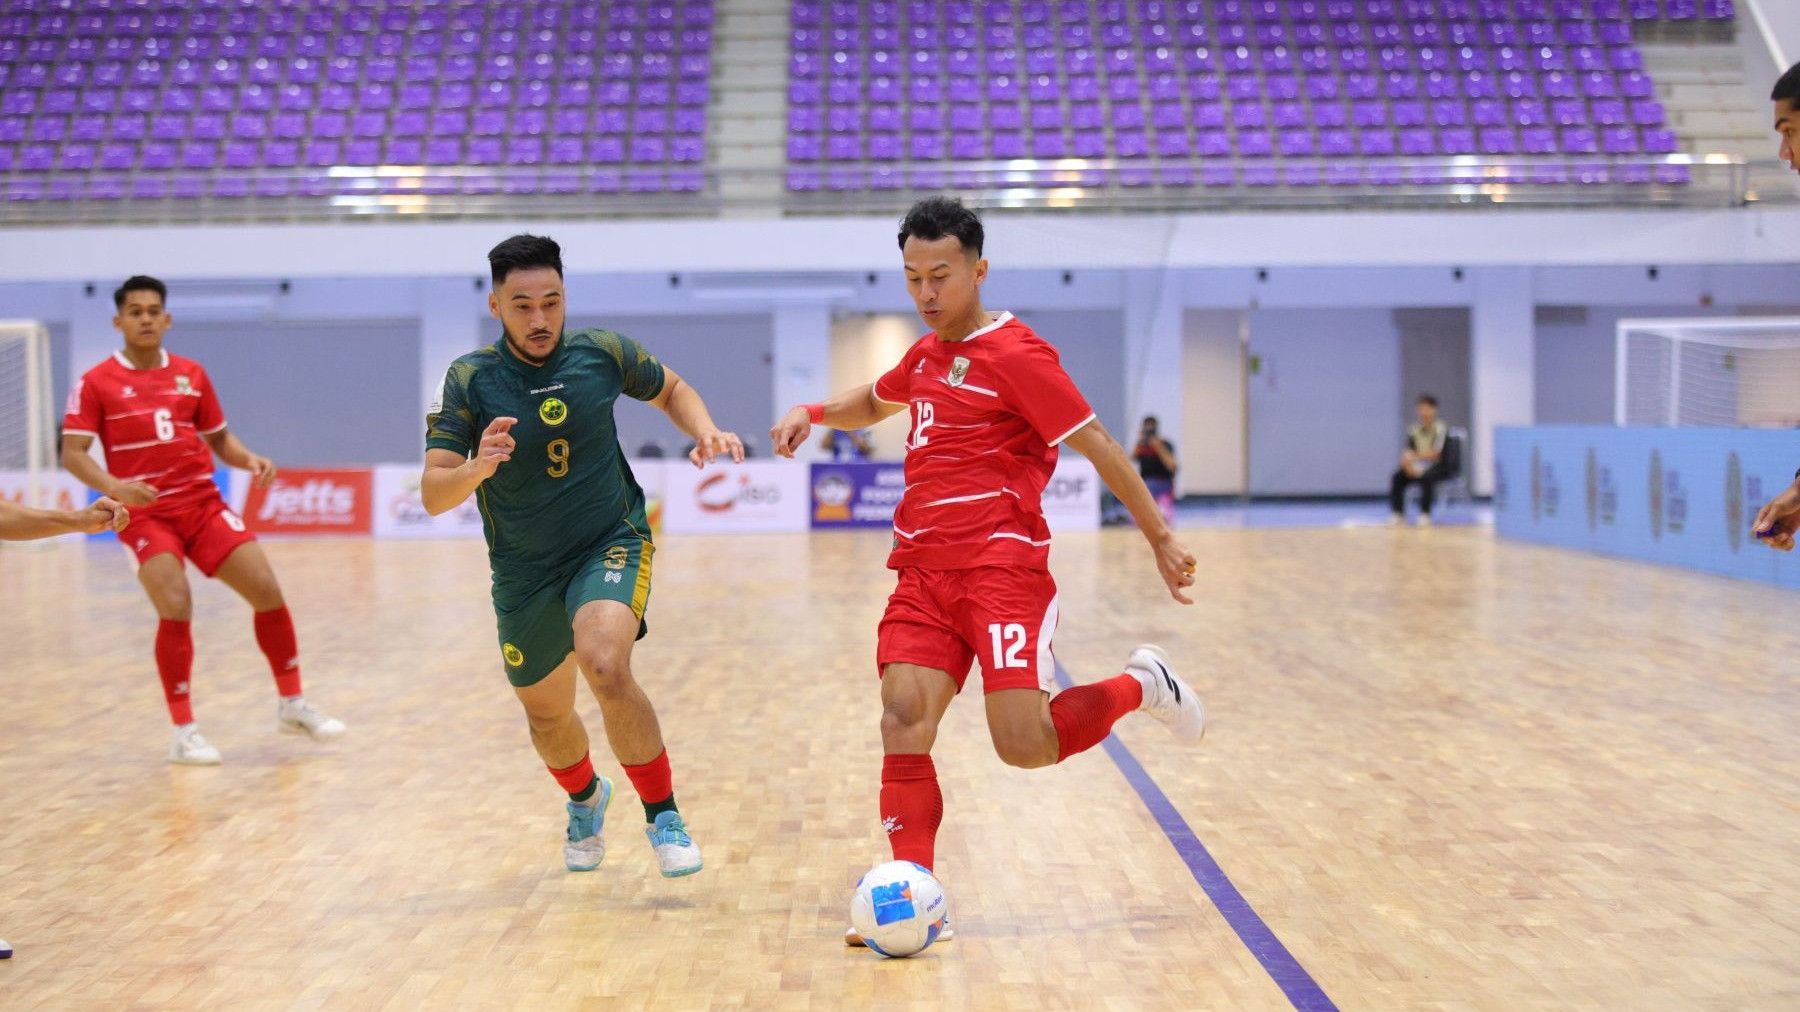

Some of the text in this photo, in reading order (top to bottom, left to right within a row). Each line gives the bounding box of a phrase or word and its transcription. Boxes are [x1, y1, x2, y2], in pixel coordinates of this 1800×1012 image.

[153, 406, 175, 442] 6
[912, 401, 934, 447] 12
[546, 438, 570, 478] 9
[260, 479, 354, 520] jetts
[221, 509, 246, 532] 6
[603, 546, 629, 570] 9
[987, 622, 1028, 670] 12
